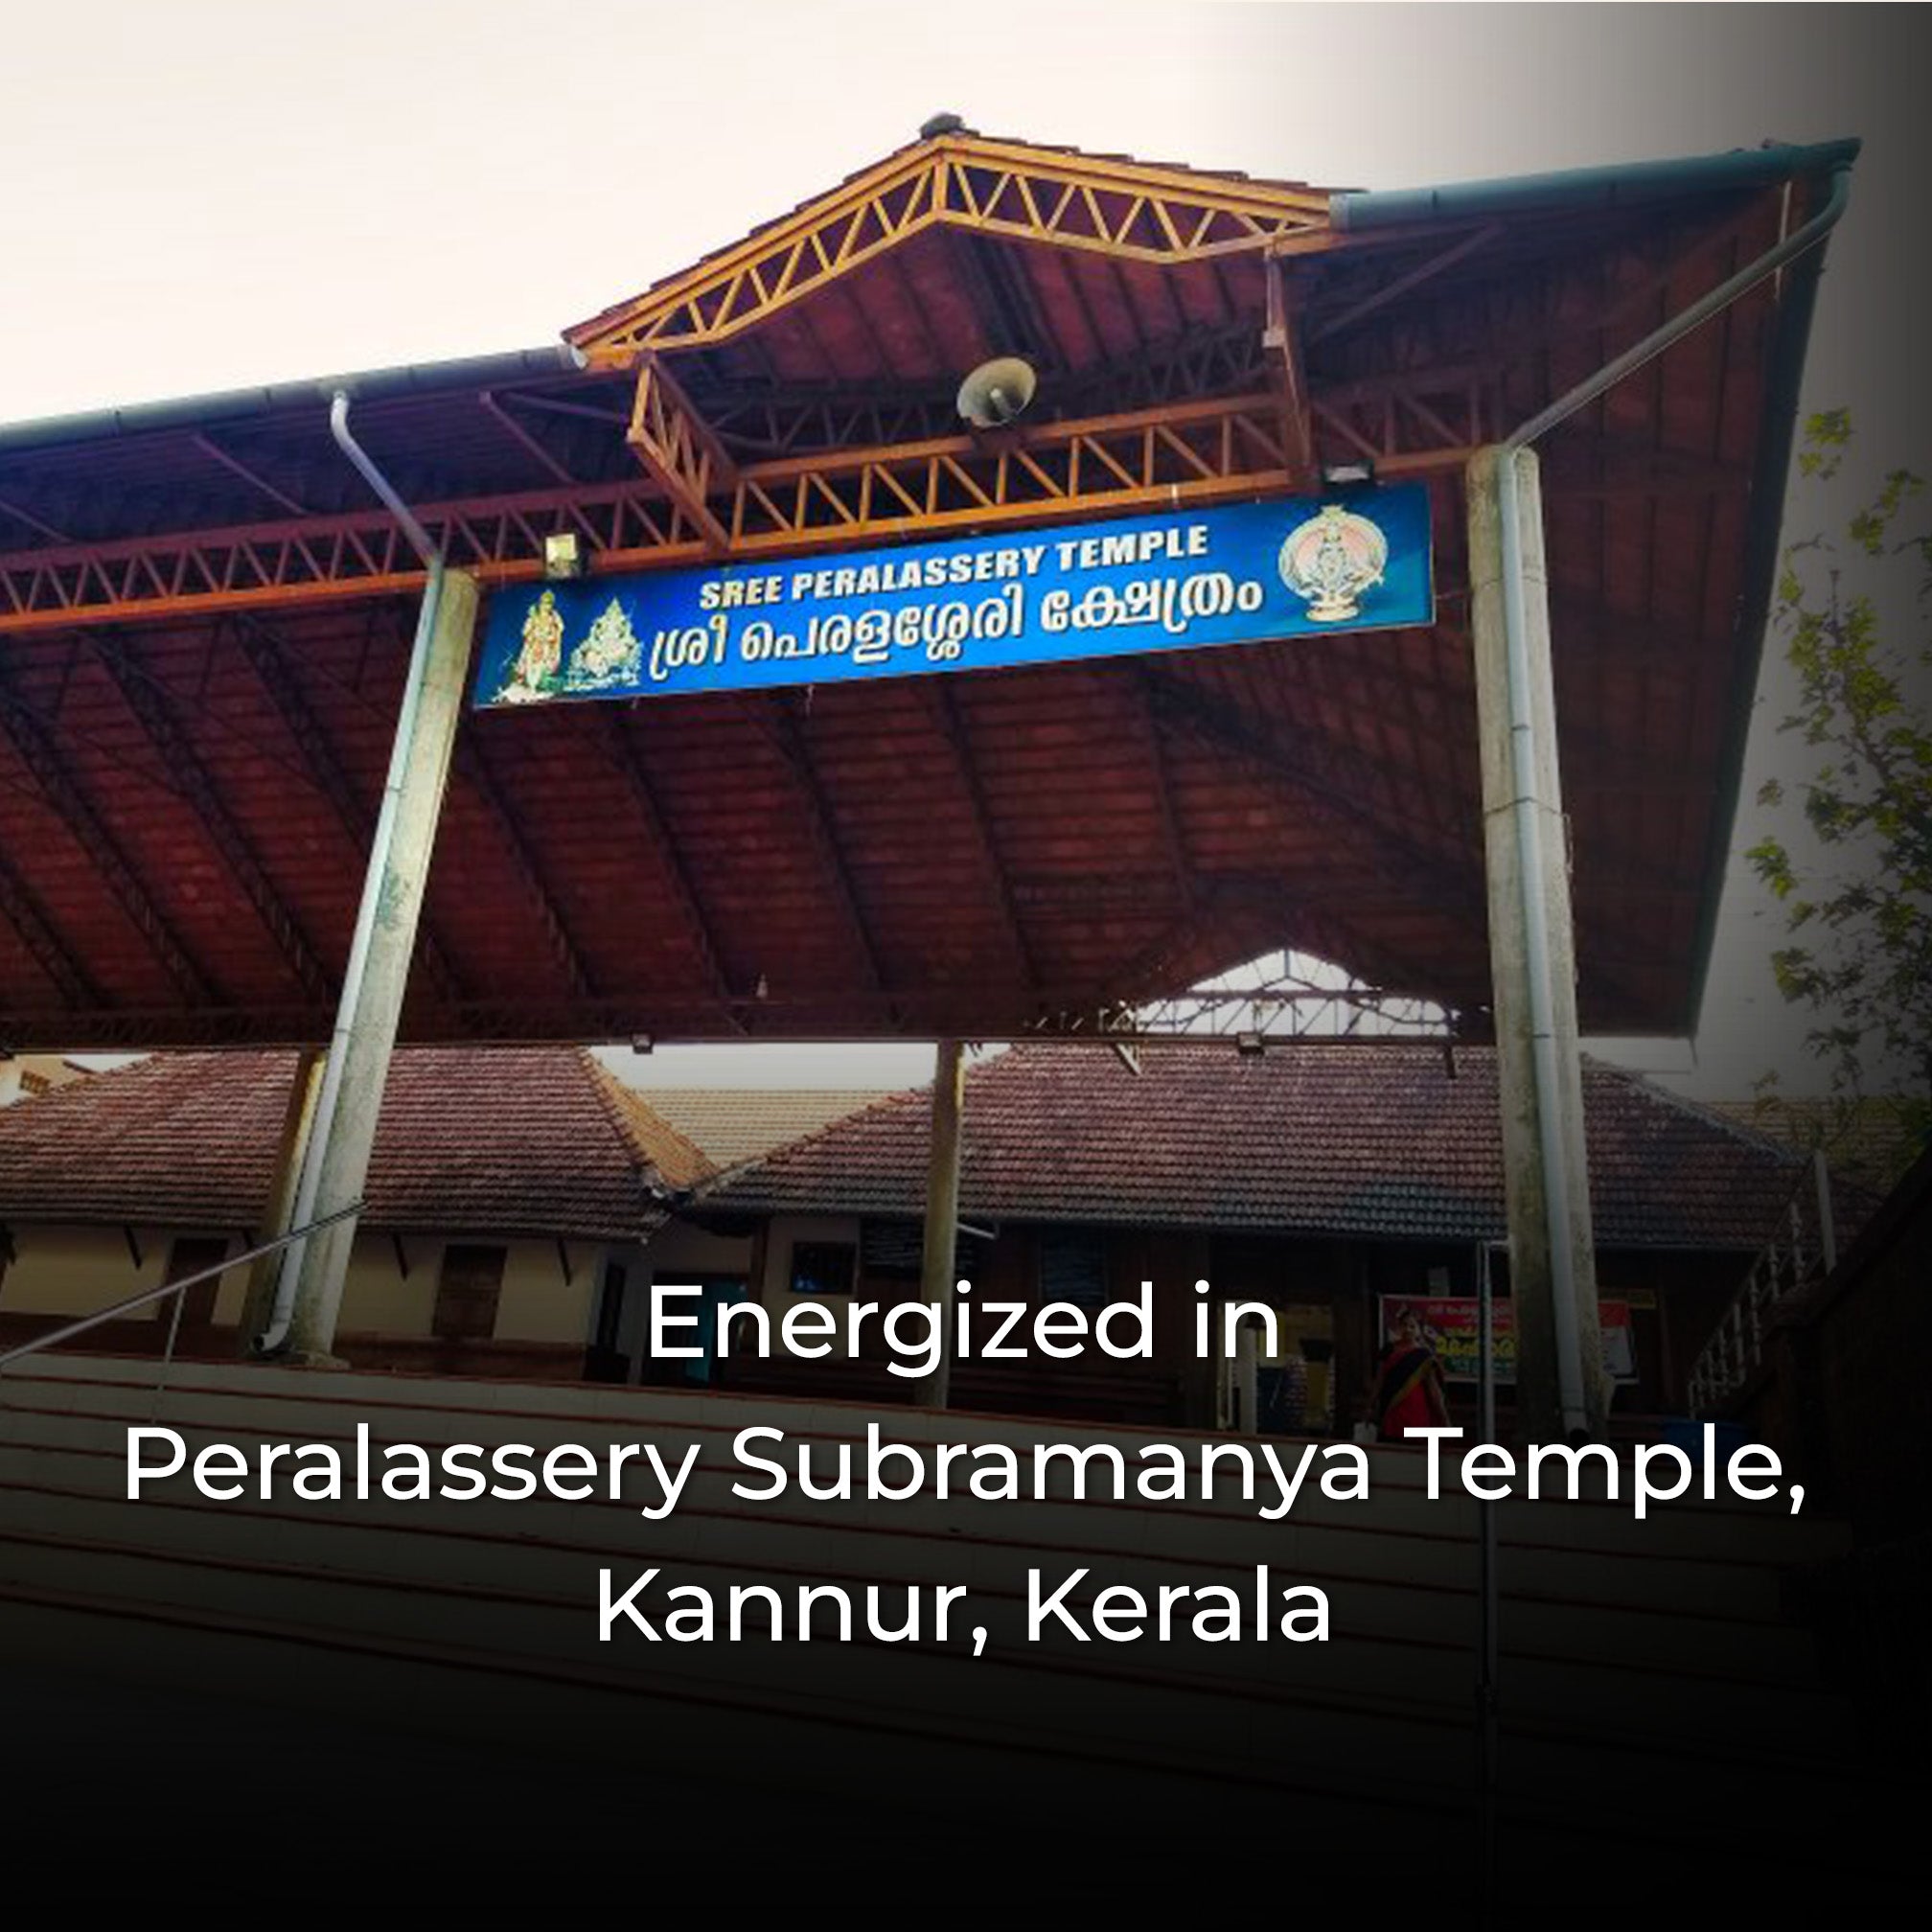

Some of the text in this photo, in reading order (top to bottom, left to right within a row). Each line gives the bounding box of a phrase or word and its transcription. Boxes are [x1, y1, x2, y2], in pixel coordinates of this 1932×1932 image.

[700, 524, 1208, 610] SREE PERALASSERY TEMPLE
[650, 572, 1263, 681] ശ്രീ പെരളശ്ശേരി ക്ഷേത്രം
